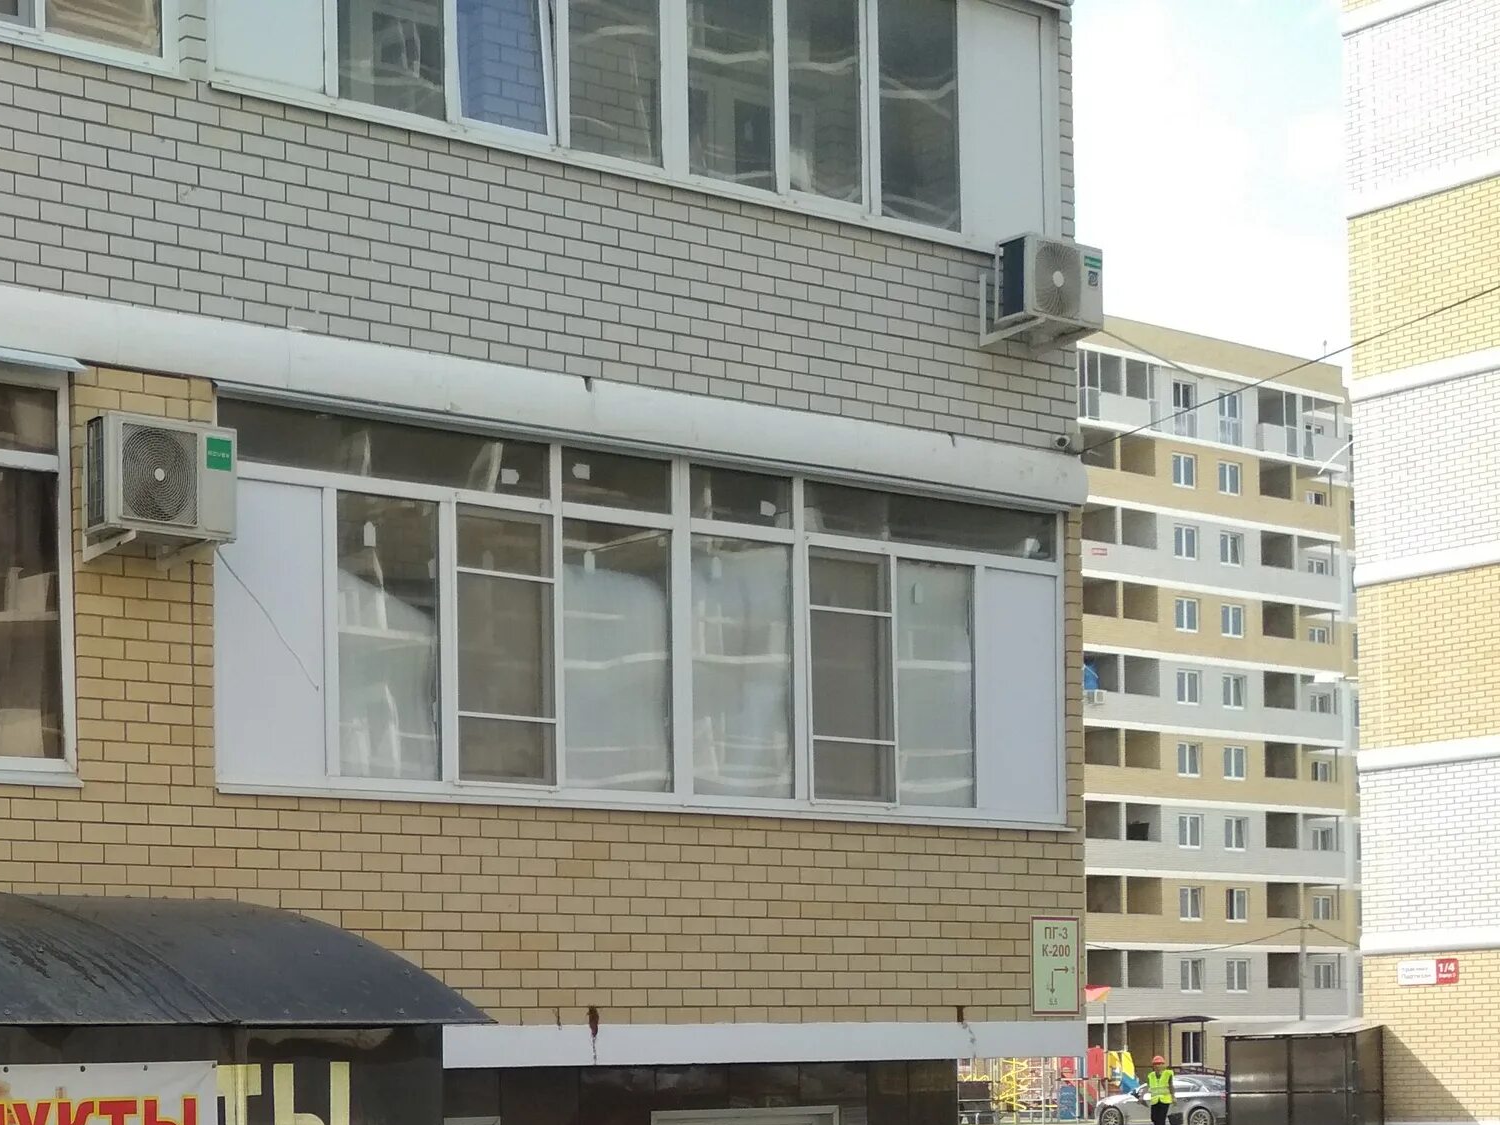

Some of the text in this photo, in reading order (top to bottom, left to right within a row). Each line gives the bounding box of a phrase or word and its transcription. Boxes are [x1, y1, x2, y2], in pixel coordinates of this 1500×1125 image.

[1044, 926, 1068, 940] ПГ-3
[1042, 944, 1070, 957] К-200
[1438, 963, 1456, 973] 1/4
